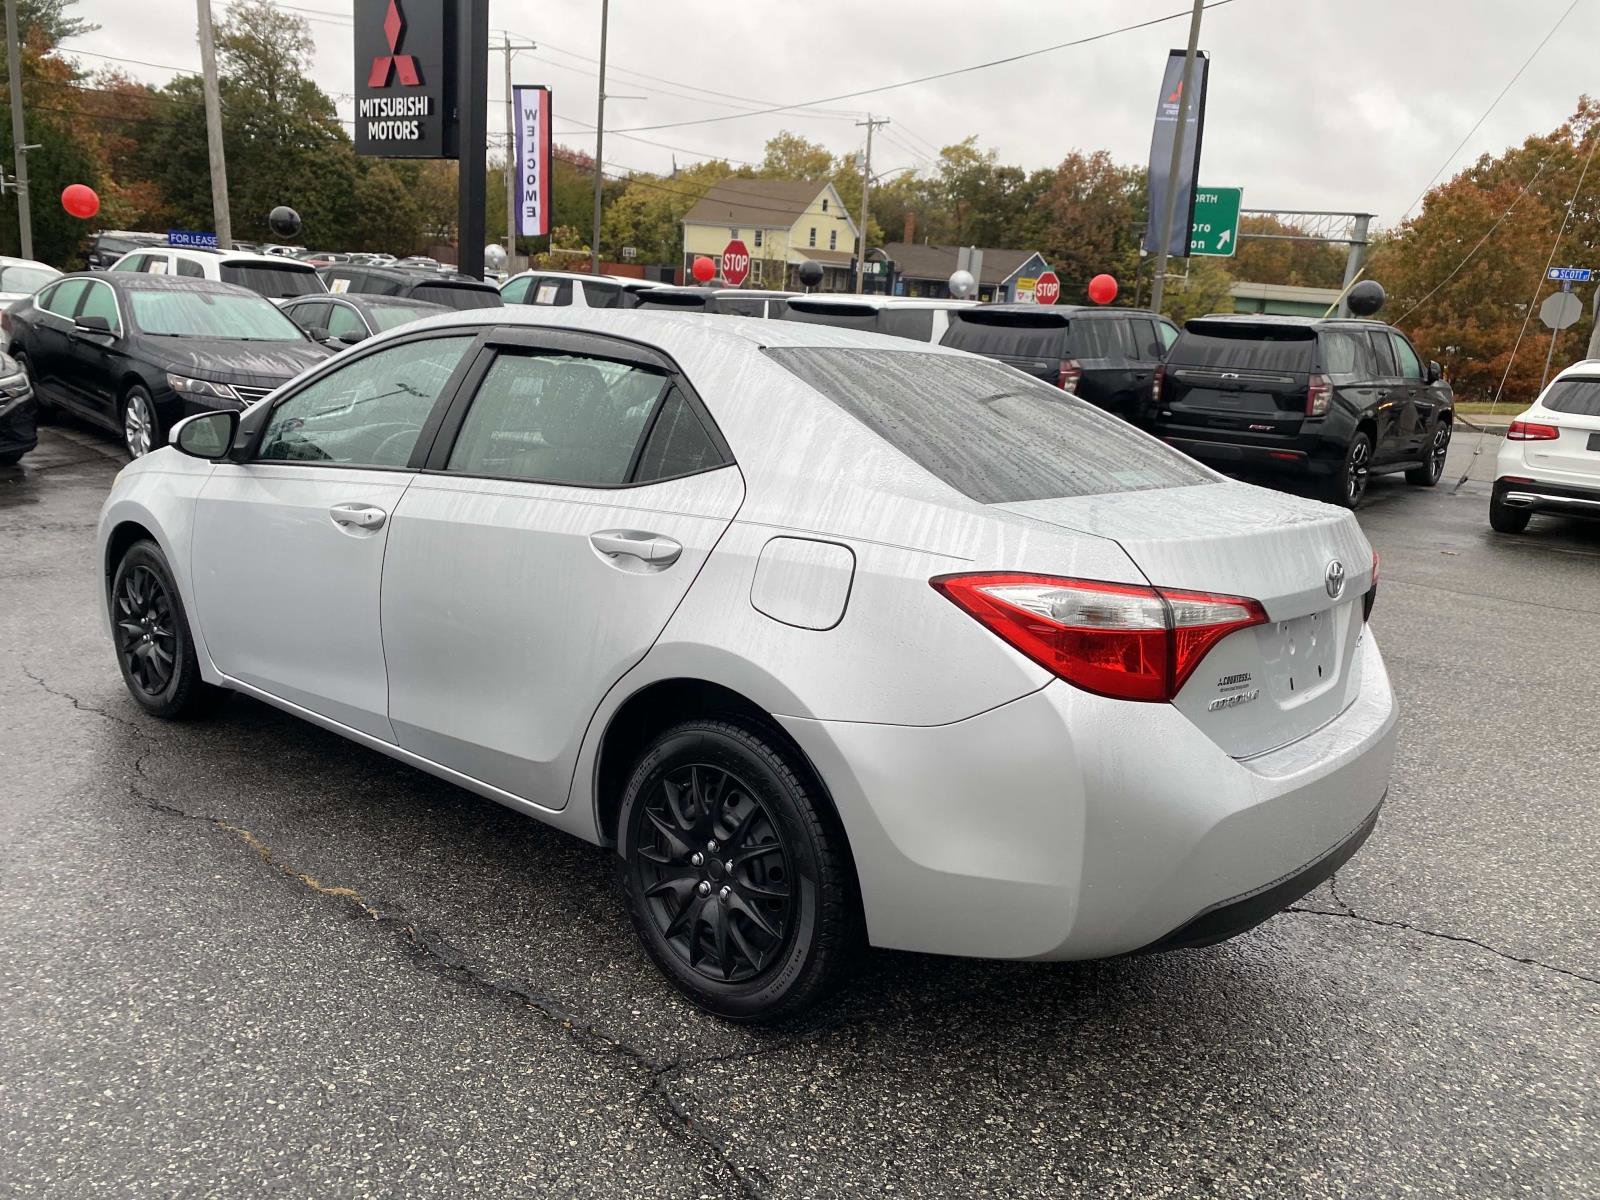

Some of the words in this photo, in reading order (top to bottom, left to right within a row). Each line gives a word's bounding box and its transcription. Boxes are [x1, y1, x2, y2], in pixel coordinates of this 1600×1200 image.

[360, 96, 428, 117] MITSUBISHI
[368, 120, 419, 140] MOTORS
[170, 233, 189, 243] FOR
[190, 235, 217, 245] LEASE
[723, 253, 748, 271] STOP
[1560, 269, 1583, 280] SCOTT
[1036, 283, 1058, 297] STOP
